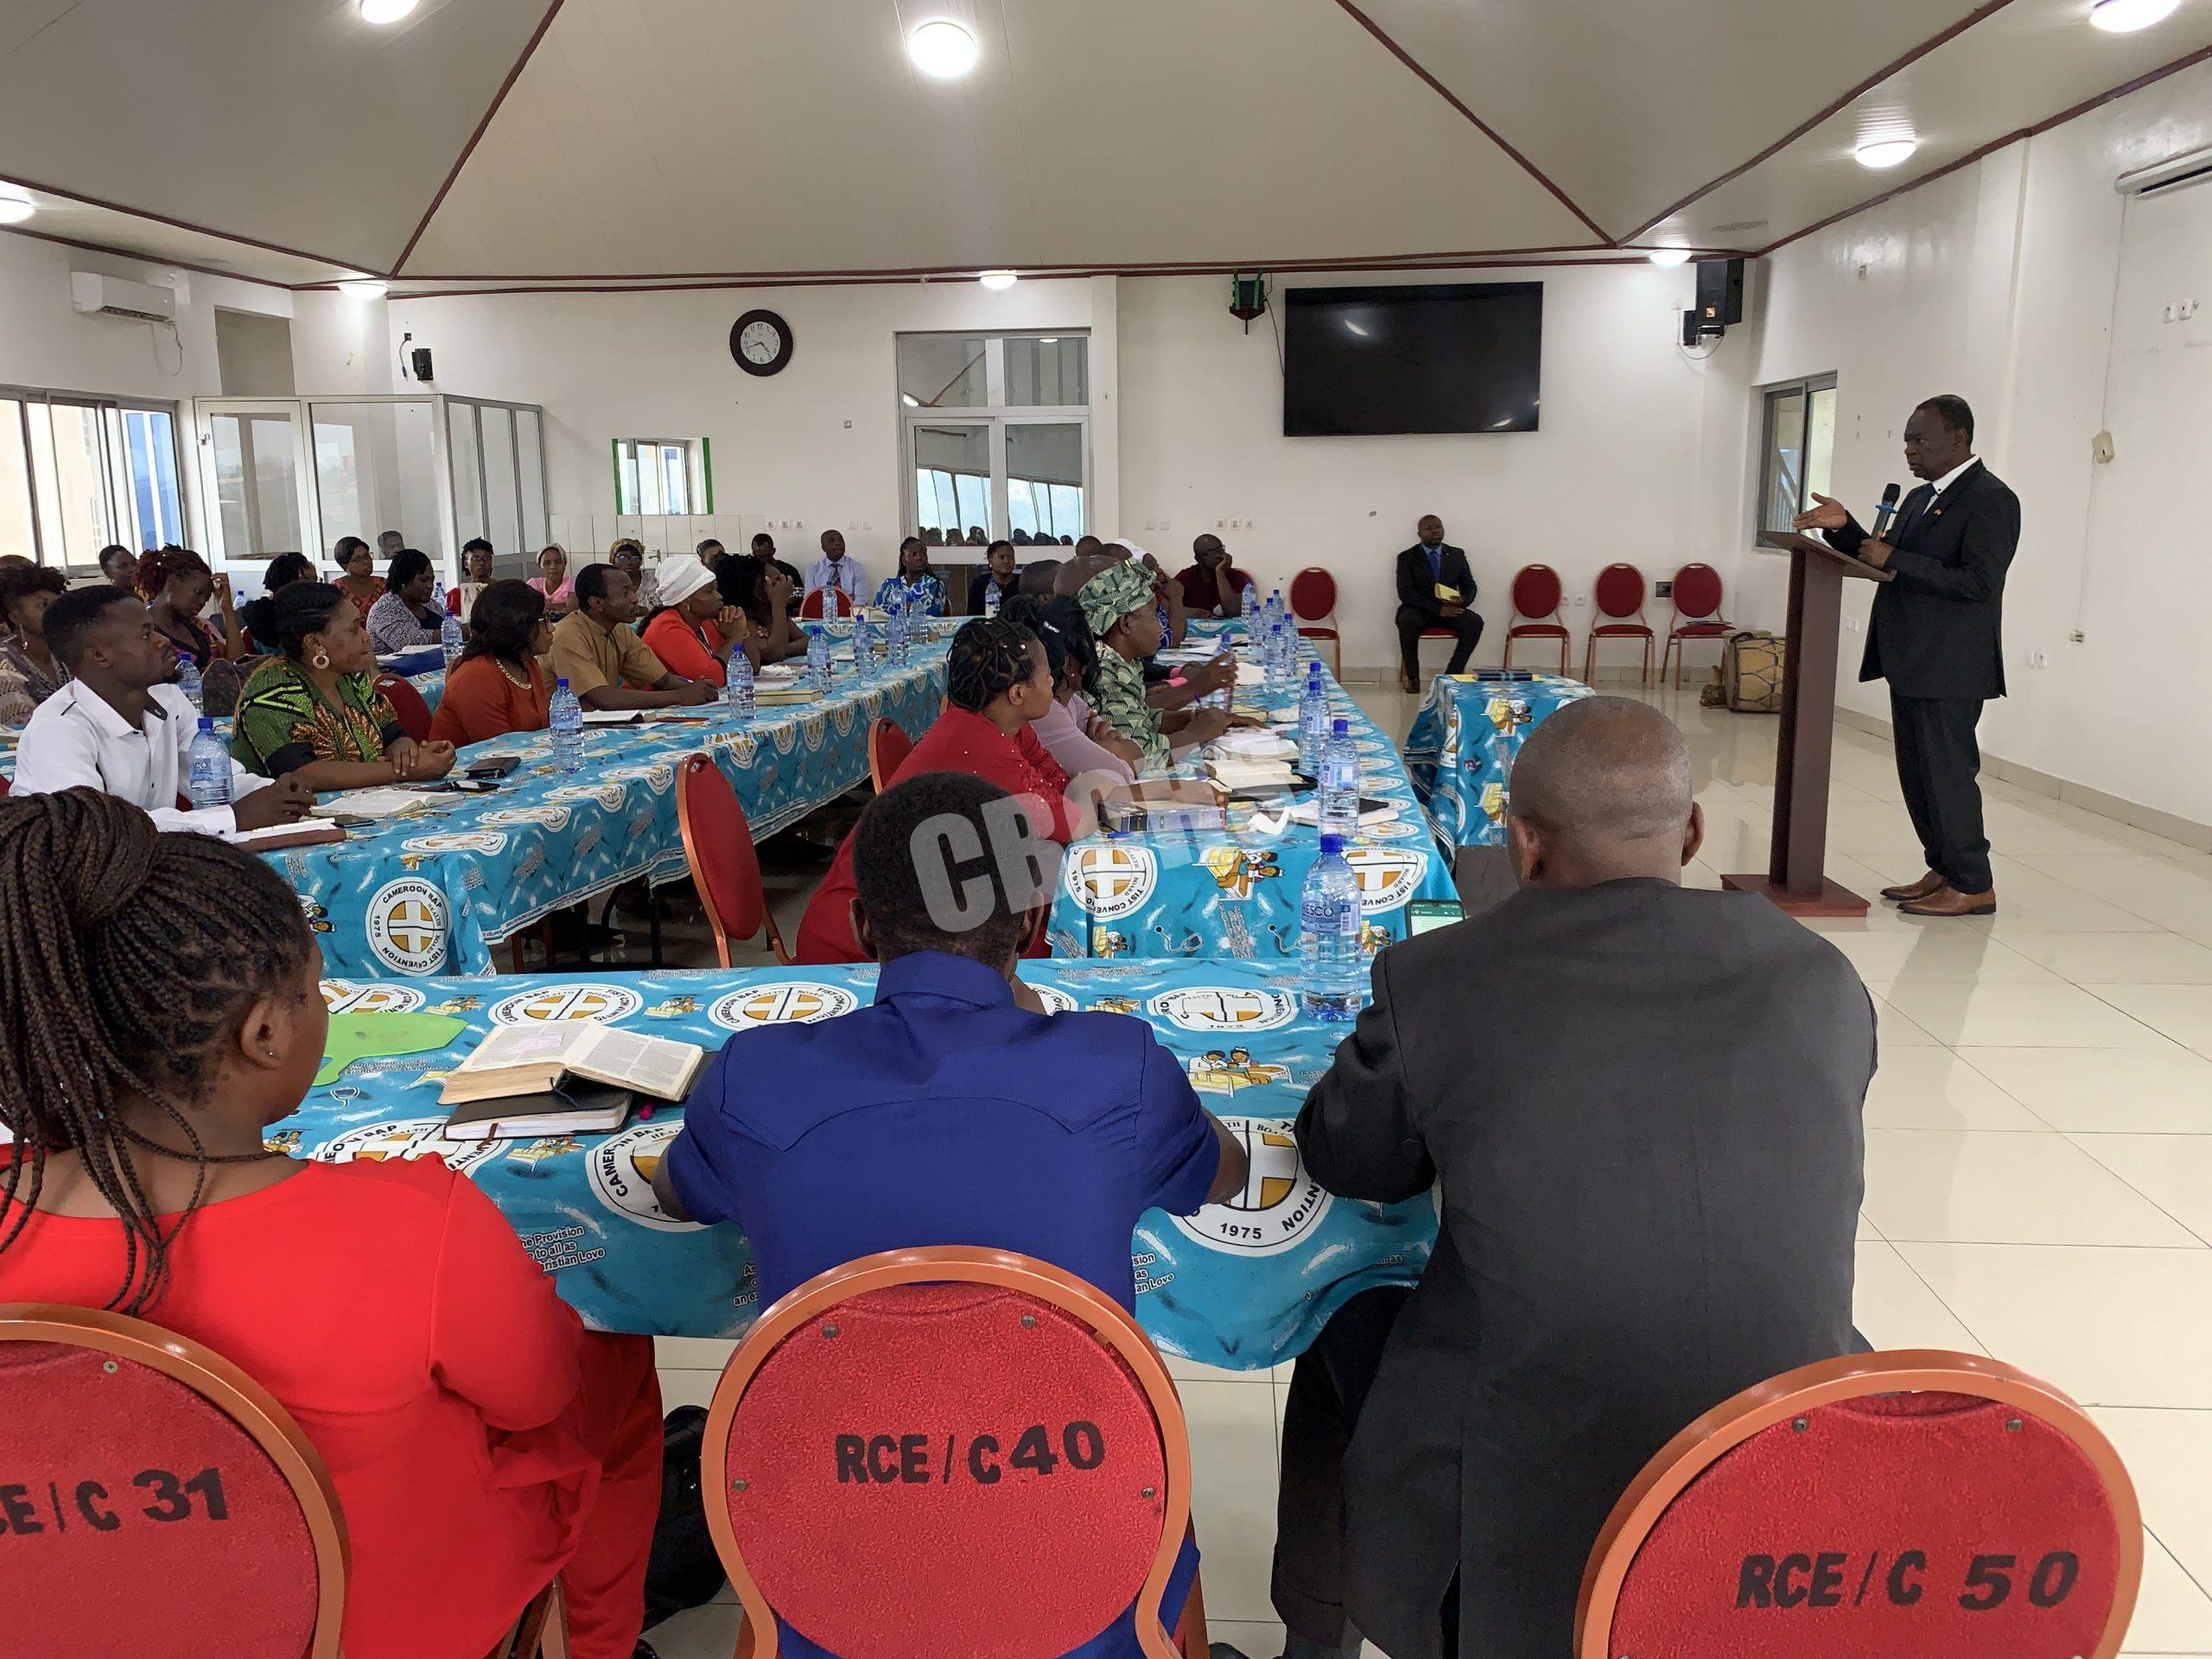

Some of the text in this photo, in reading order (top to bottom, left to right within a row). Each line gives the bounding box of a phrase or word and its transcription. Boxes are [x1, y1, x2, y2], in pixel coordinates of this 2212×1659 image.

[428, 893, 442, 909] BAP
[373, 915, 382, 938] 1975
[534, 1226, 584, 1245] Provision
[1220, 1222, 1262, 1240] 1975
[535, 1248, 548, 1259] to
[549, 1243, 563, 1255] all
[563, 1242, 577, 1252] as
[579, 1248, 605, 1263] Love
[1149, 1273, 1174, 1289] Love
[132, 1467, 228, 1522] 31
[1958, 1550, 2081, 1612] 50
